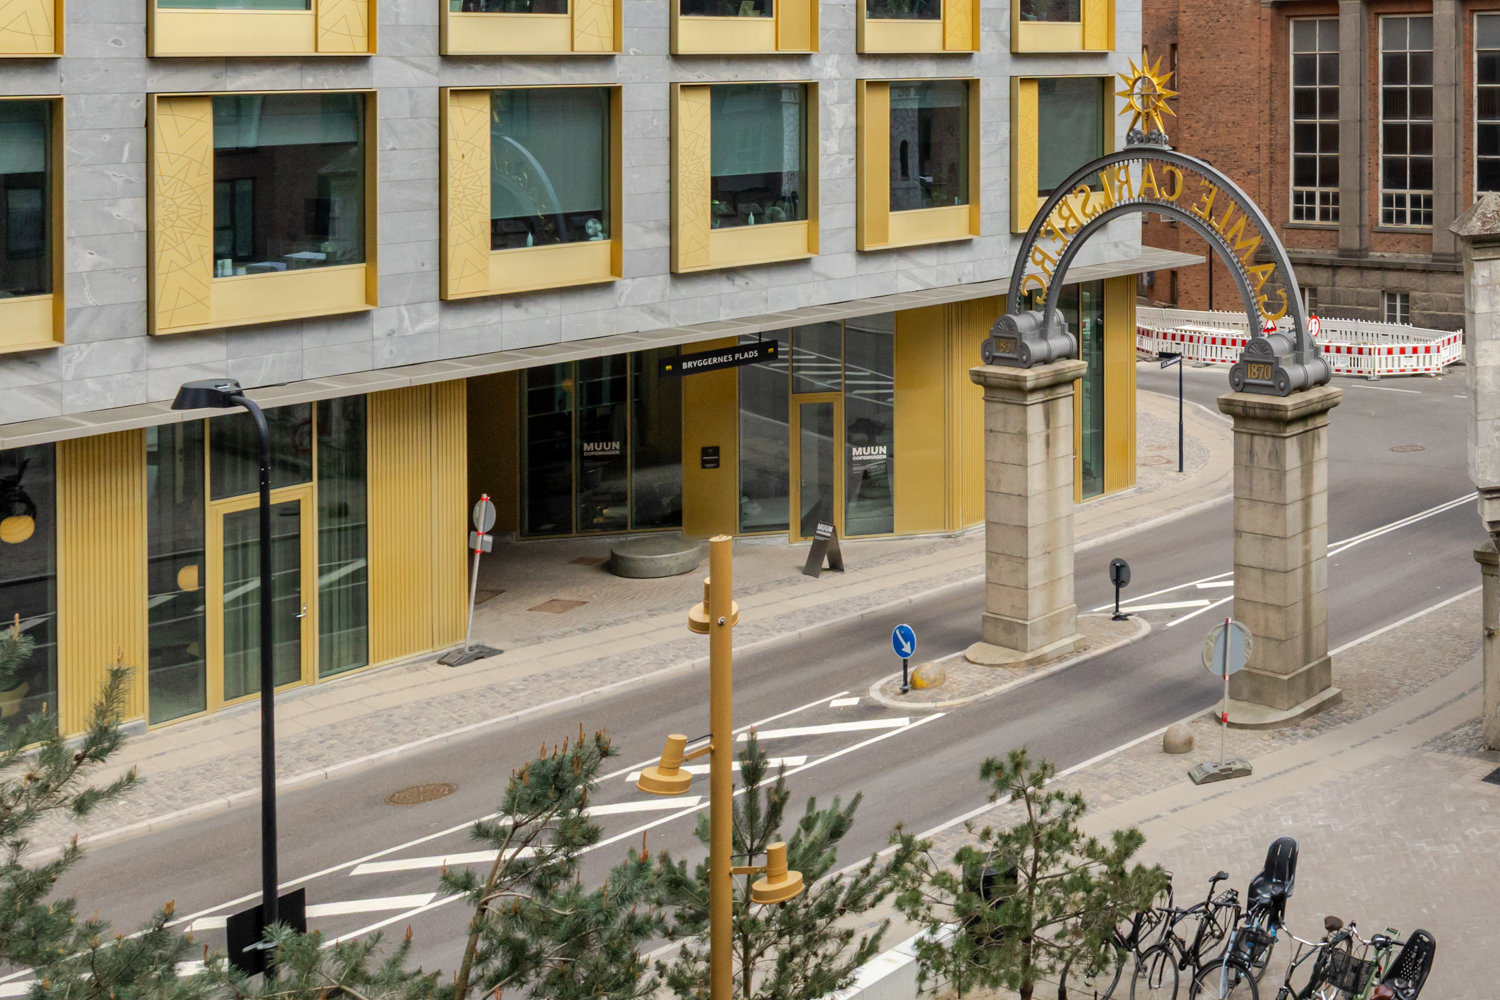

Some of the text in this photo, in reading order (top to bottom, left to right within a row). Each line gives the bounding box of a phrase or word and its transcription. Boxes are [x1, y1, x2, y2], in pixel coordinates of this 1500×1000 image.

[682, 349, 759, 370] BRYGGERNES PLADS
[1247, 363, 1272, 380] 1870
[583, 441, 620, 452] MUUN
[852, 446, 887, 456] MUUN
